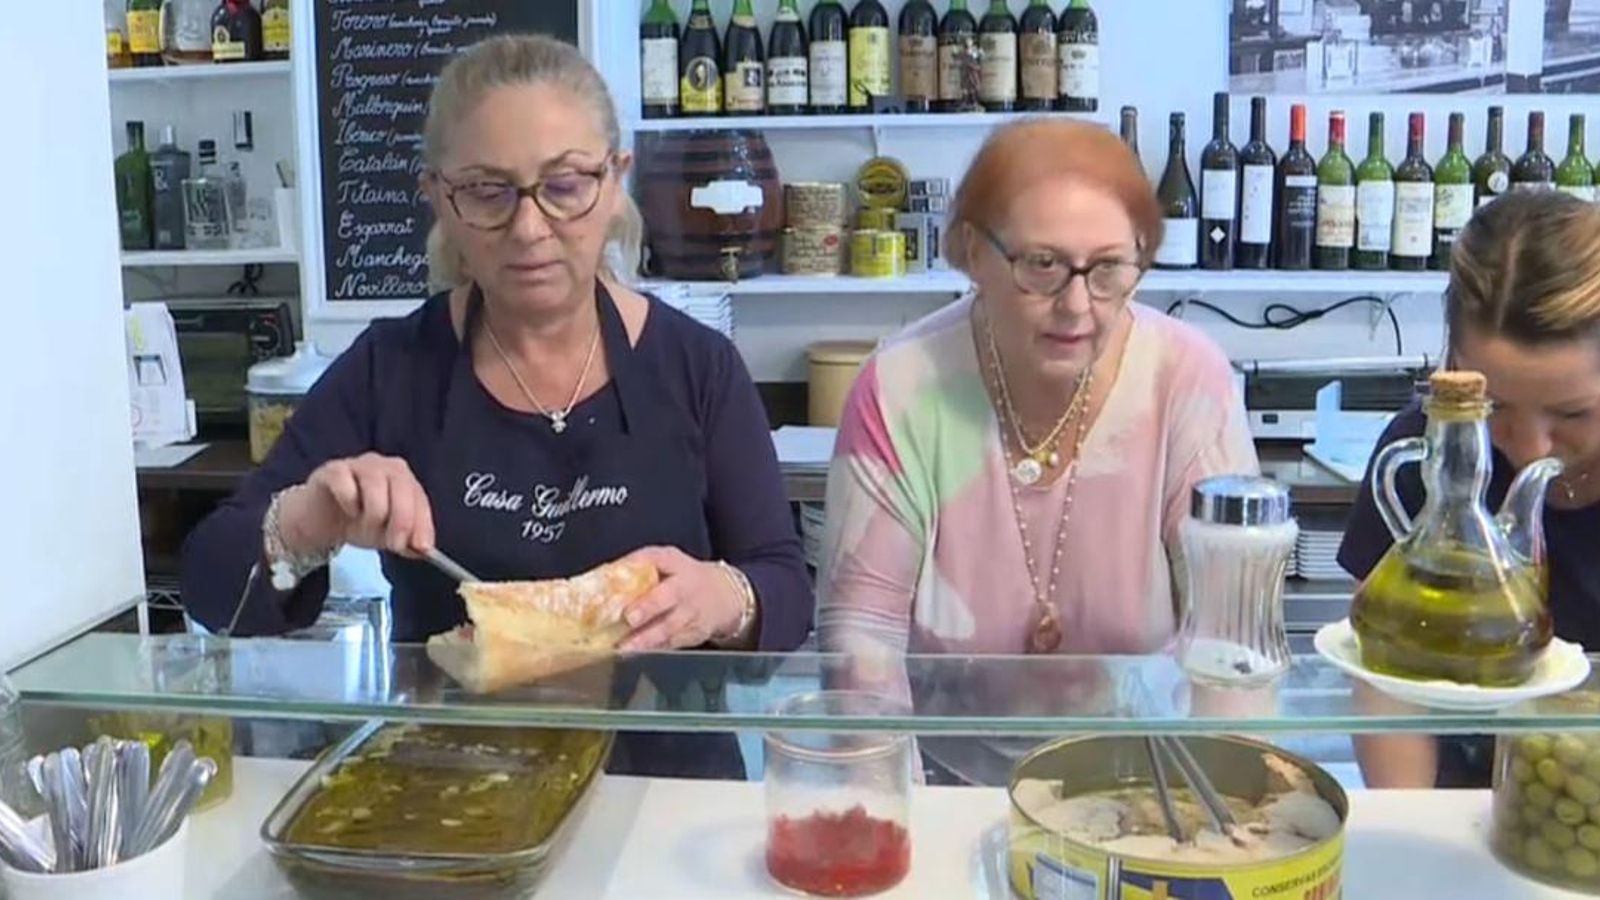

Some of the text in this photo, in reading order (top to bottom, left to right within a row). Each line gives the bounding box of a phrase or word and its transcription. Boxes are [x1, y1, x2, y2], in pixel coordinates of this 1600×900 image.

[331, 9, 388, 32] Torero
[330, 36, 412, 60] Marinero
[337, 179, 409, 204] Titaina
[337, 209, 415, 244] Esgarrat
[334, 272, 427, 298] Novillero
[464, 472, 628, 519] Casa Guillermo
[521, 519, 566, 543] 1957
